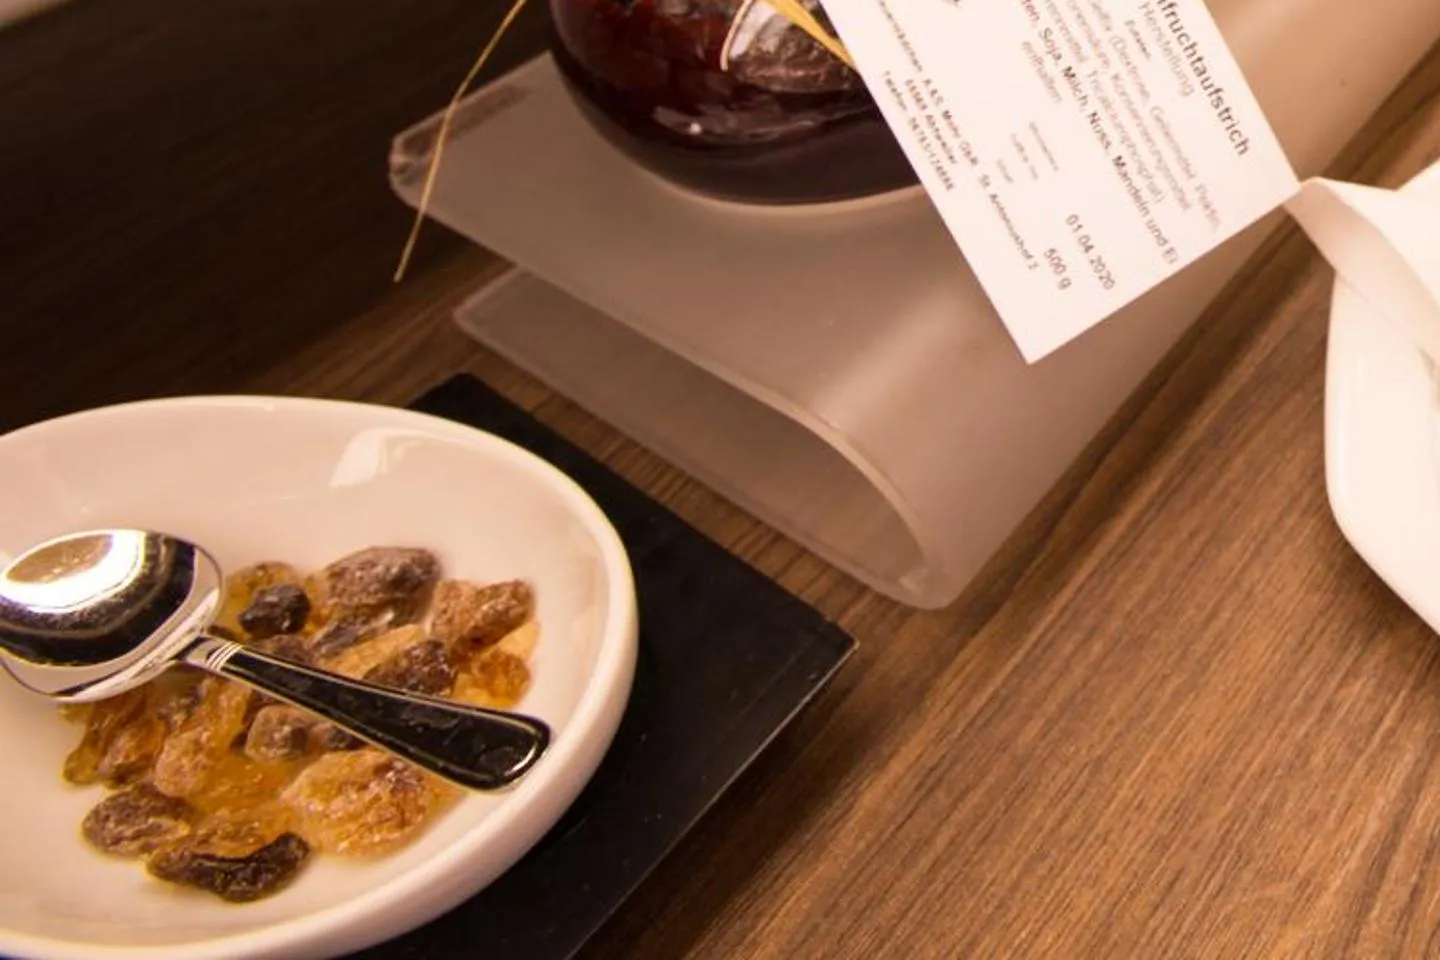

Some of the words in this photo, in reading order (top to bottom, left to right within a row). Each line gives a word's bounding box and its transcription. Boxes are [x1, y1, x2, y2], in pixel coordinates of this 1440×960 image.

[1137, 0, 1195, 98] Herstellung
[1111, 154, 1150, 217] Mandeln
[1144, 218, 1170, 248] und
[1043, 247, 1067, 276] 500
